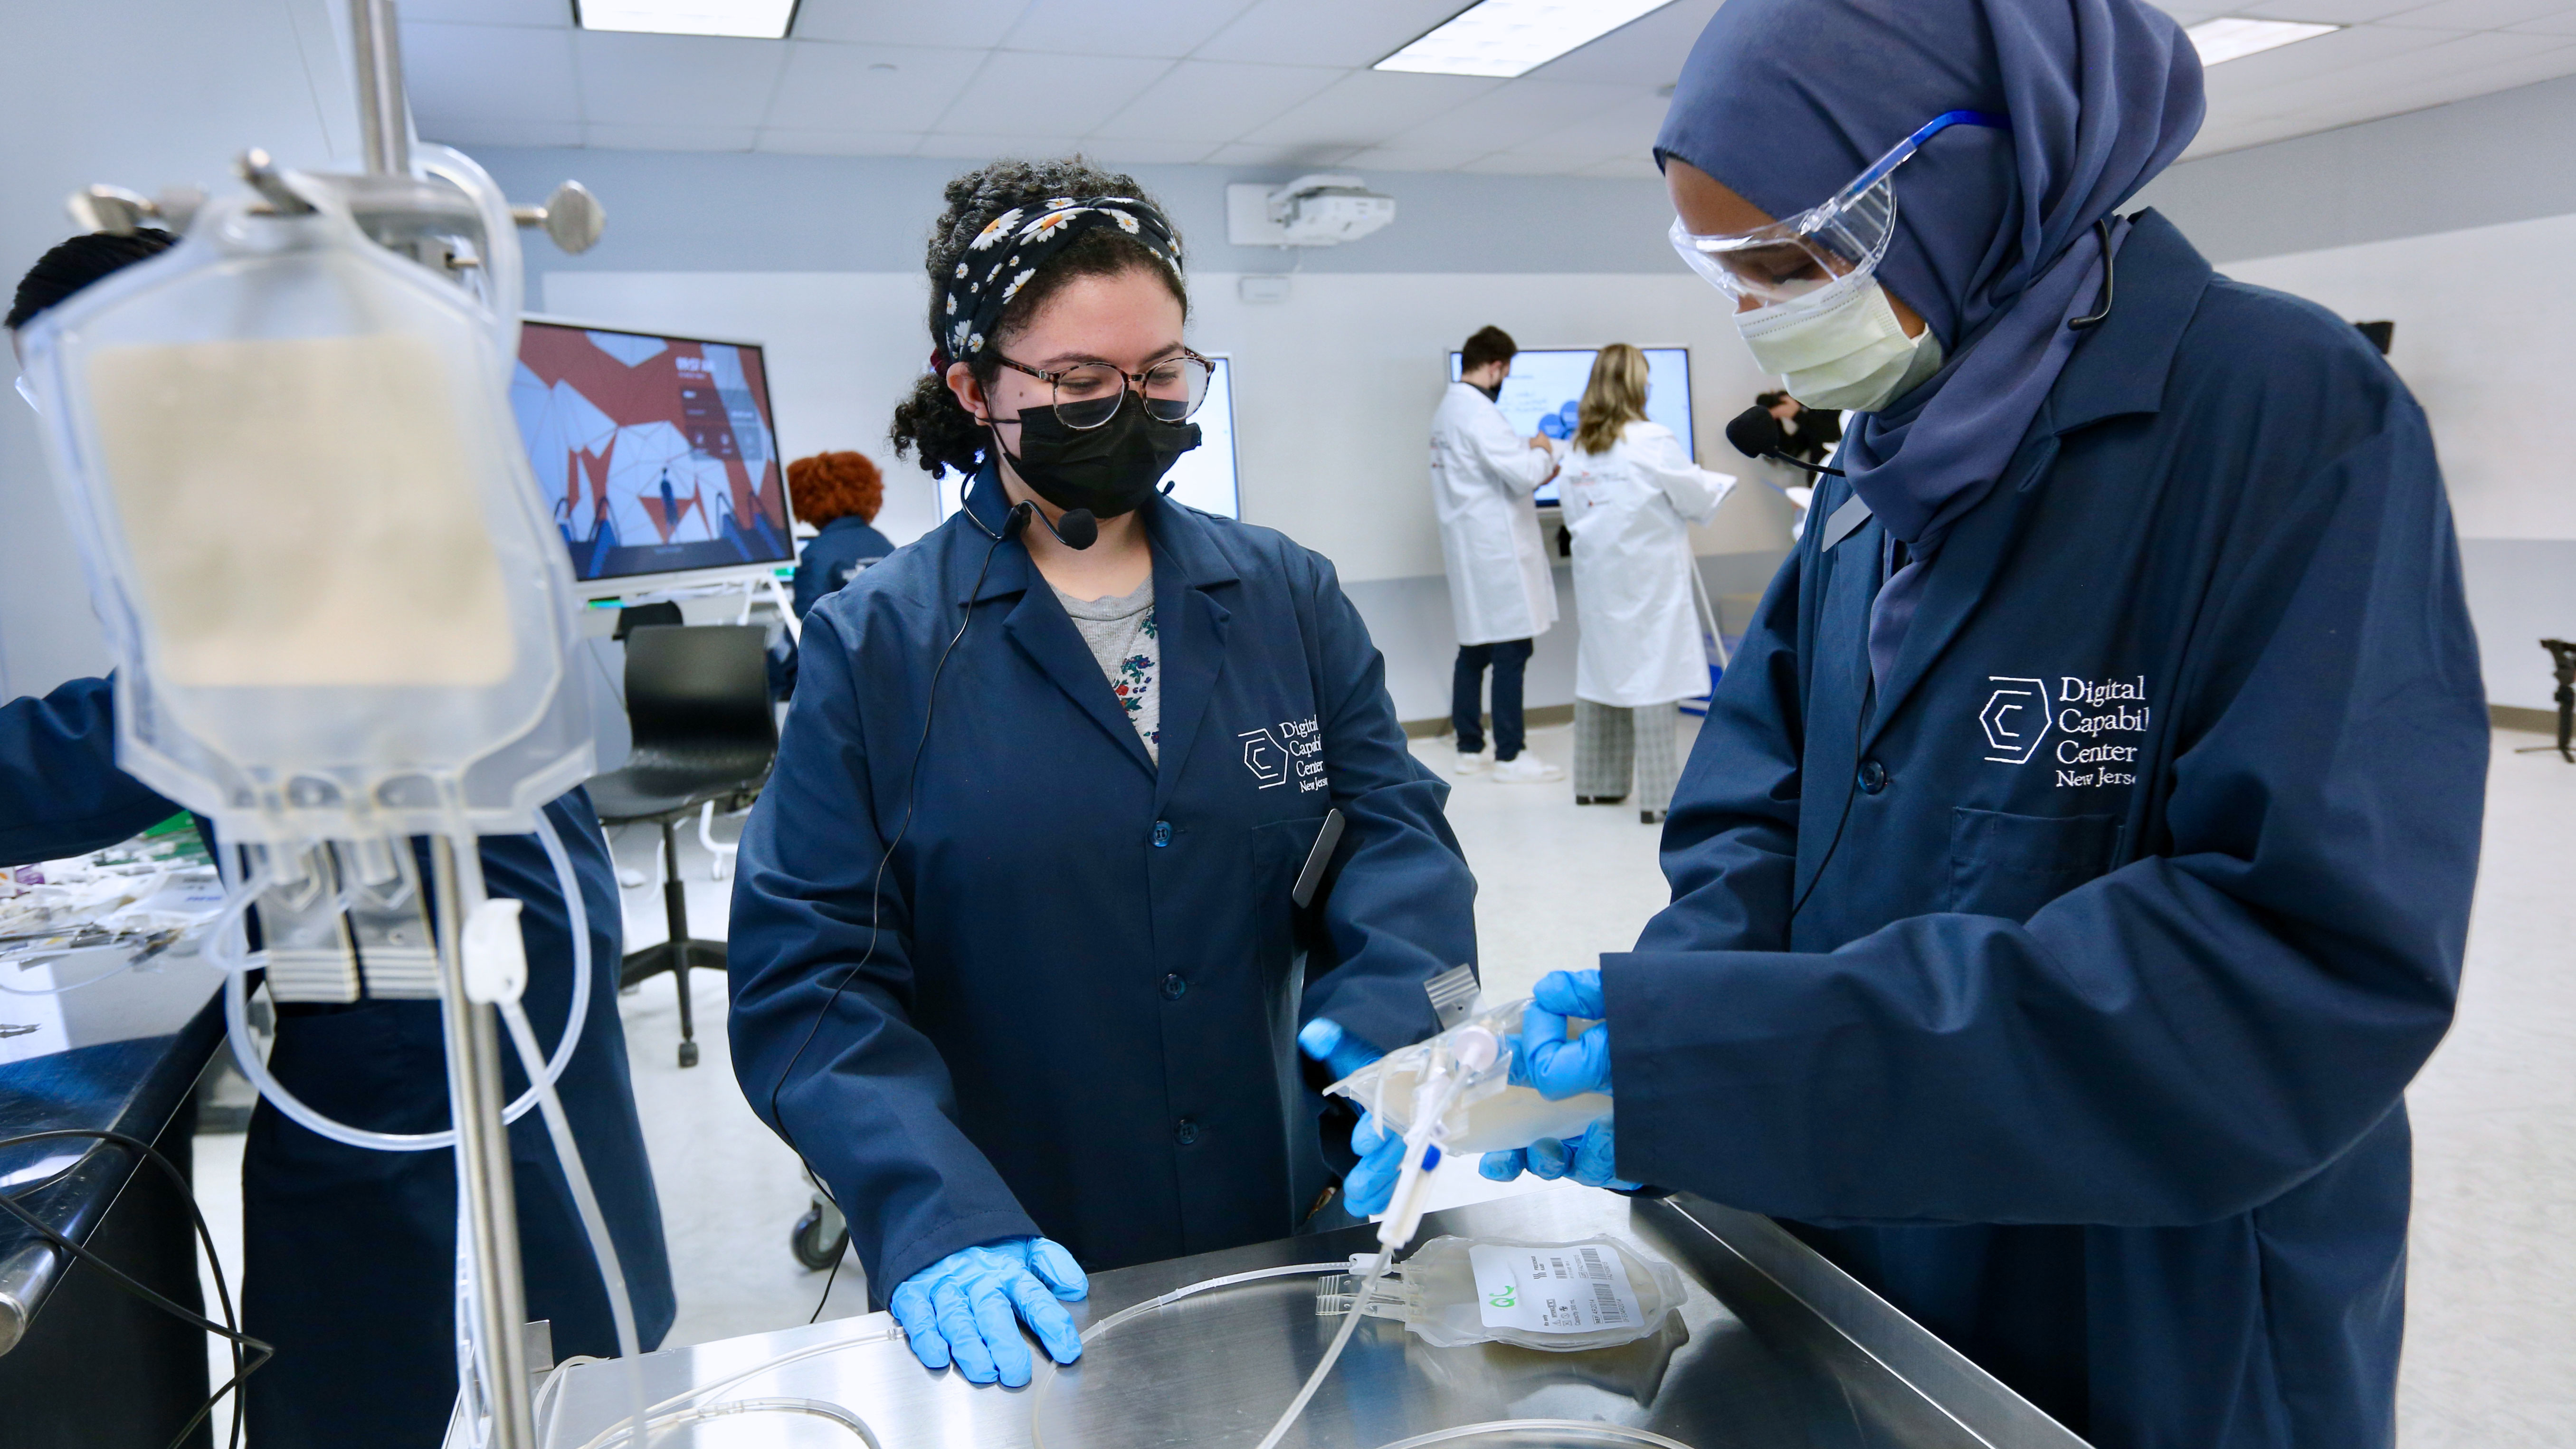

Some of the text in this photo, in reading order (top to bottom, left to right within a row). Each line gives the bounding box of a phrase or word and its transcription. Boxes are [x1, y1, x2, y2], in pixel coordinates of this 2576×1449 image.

[2059, 675, 2146, 707] Digital
[1279, 714, 1319, 738] Digital
[2059, 705, 2149, 737] Capabil
[2056, 740, 2138, 764] Center
[1296, 761, 1323, 777] Center
[1299, 780, 1315, 793] New
[2055, 770, 2094, 787] New
[1589, 1299, 1598, 1314] 4R2014
[1573, 1311, 1581, 1325] Capacity
